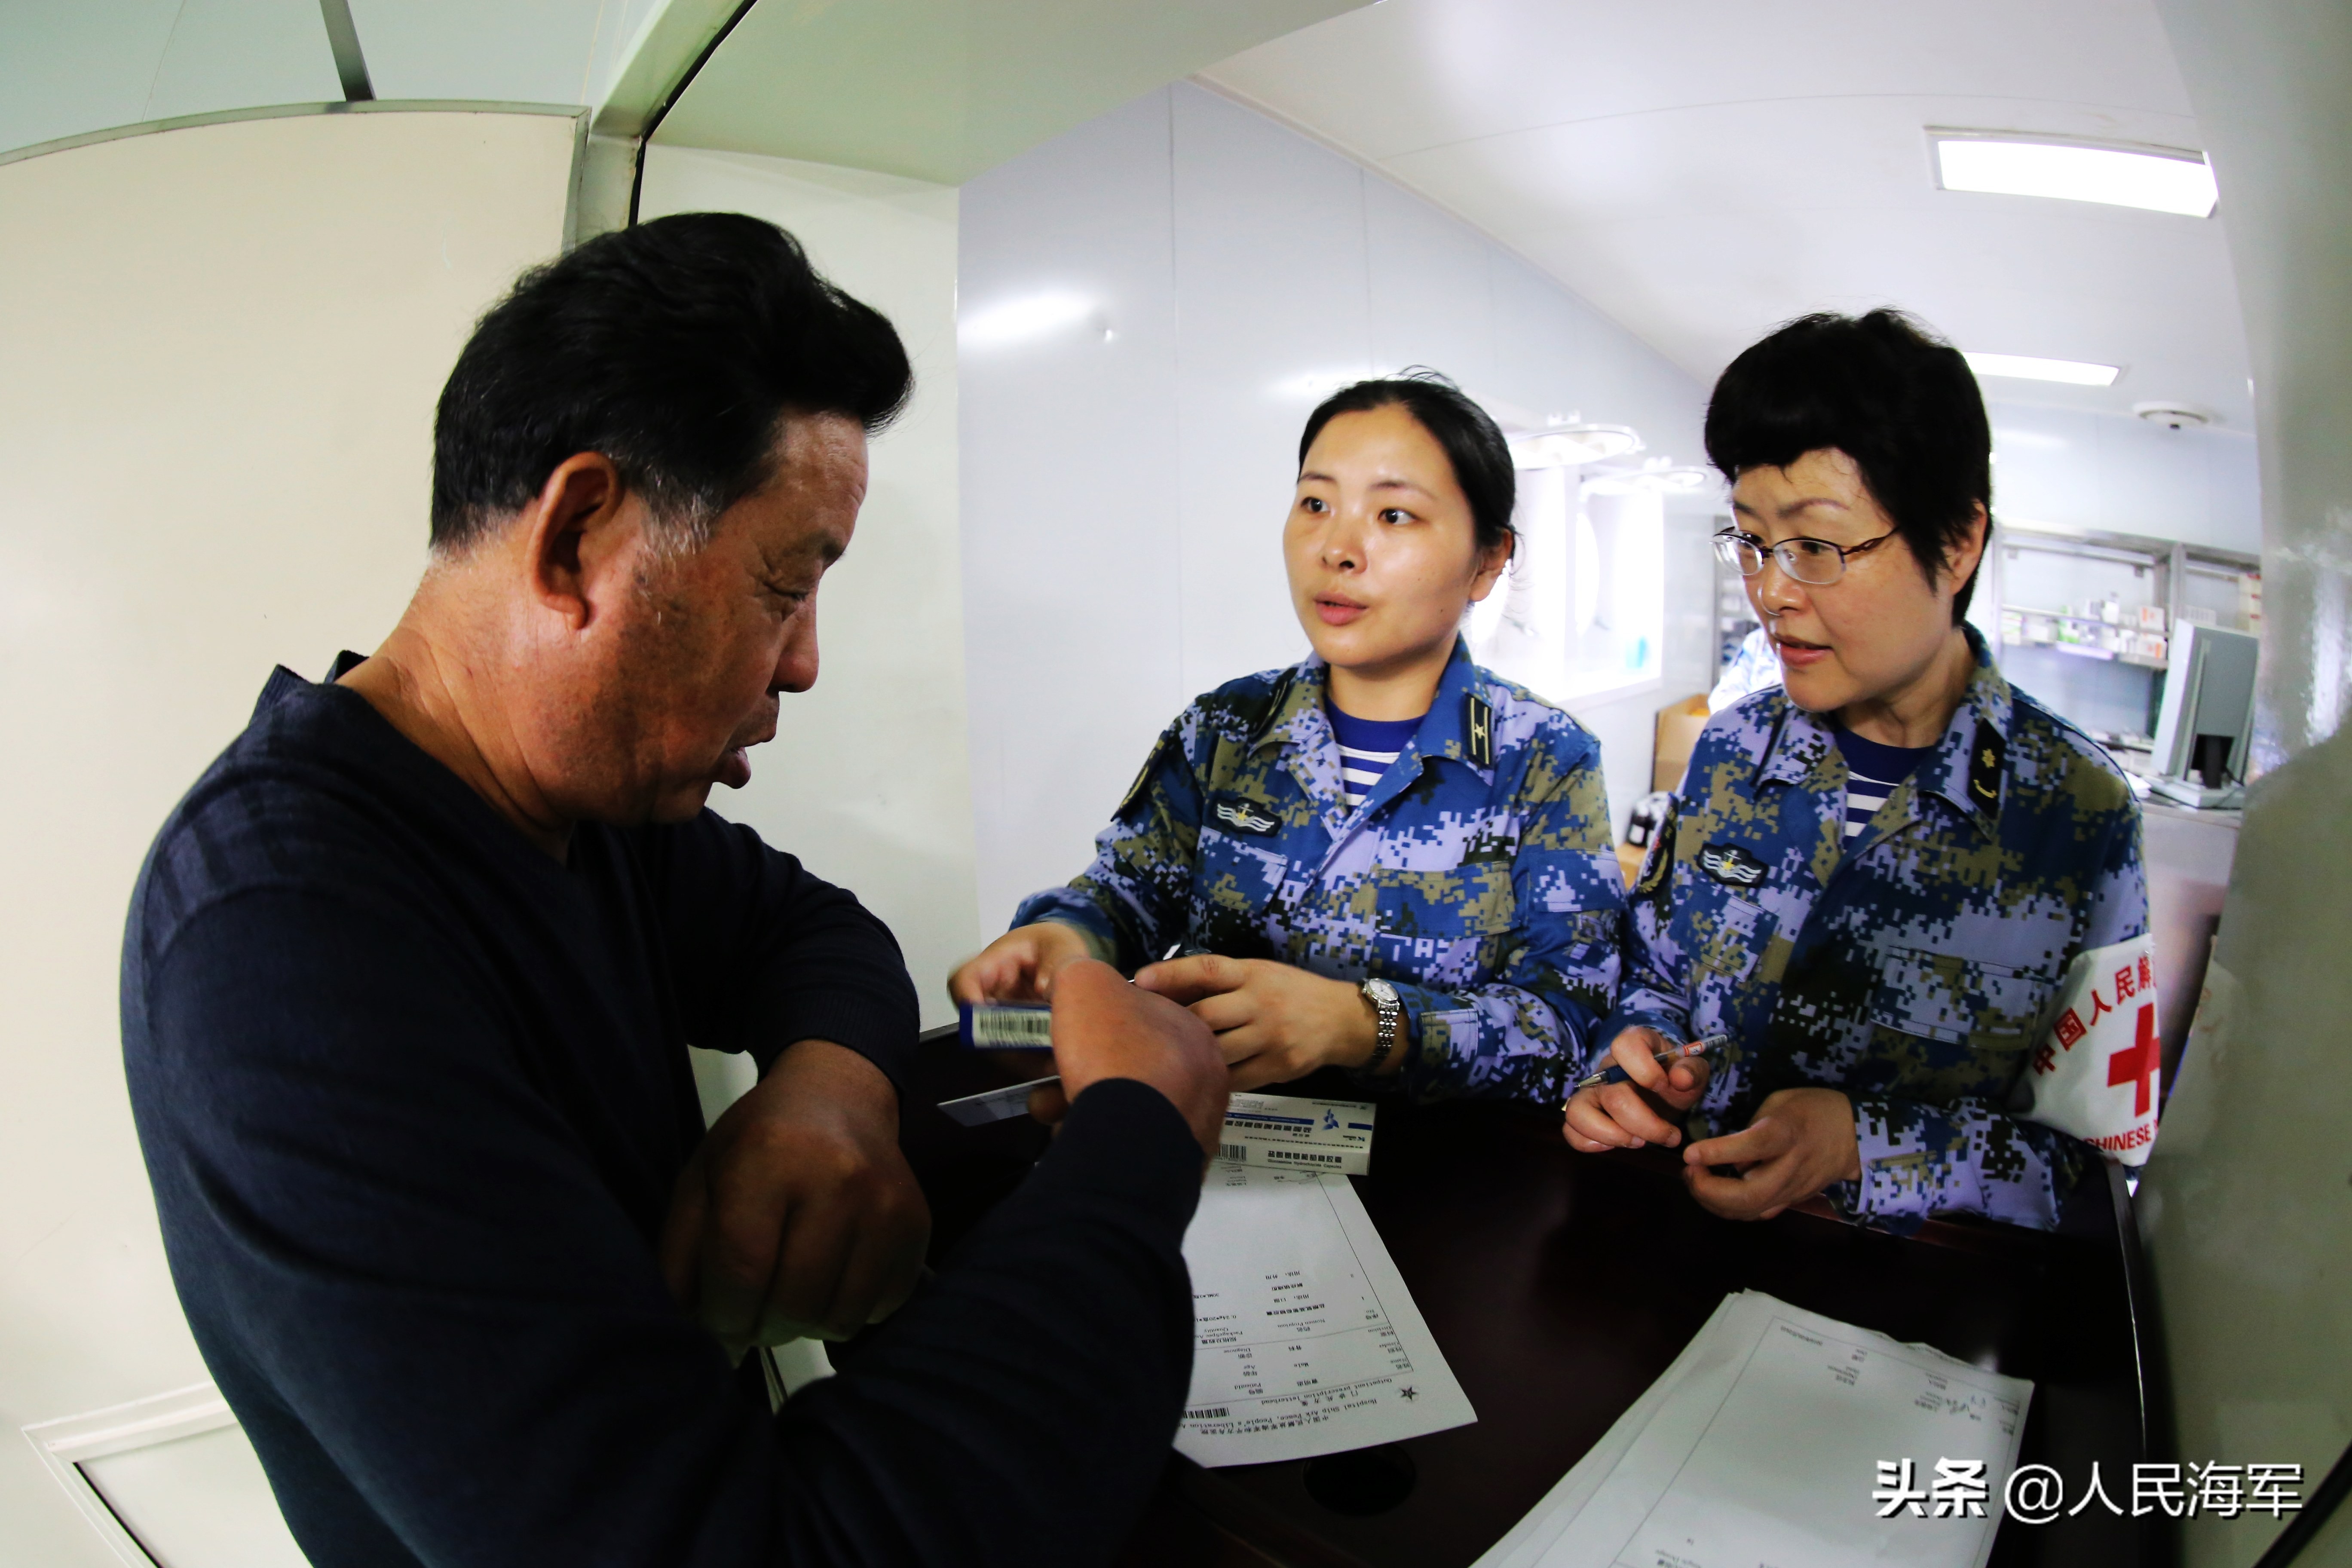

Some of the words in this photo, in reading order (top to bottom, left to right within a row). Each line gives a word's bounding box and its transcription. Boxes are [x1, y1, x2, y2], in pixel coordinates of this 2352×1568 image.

[2032, 956, 2156, 1076] 中国人民解
[1344, 1398, 1377, 1410] Hospital
